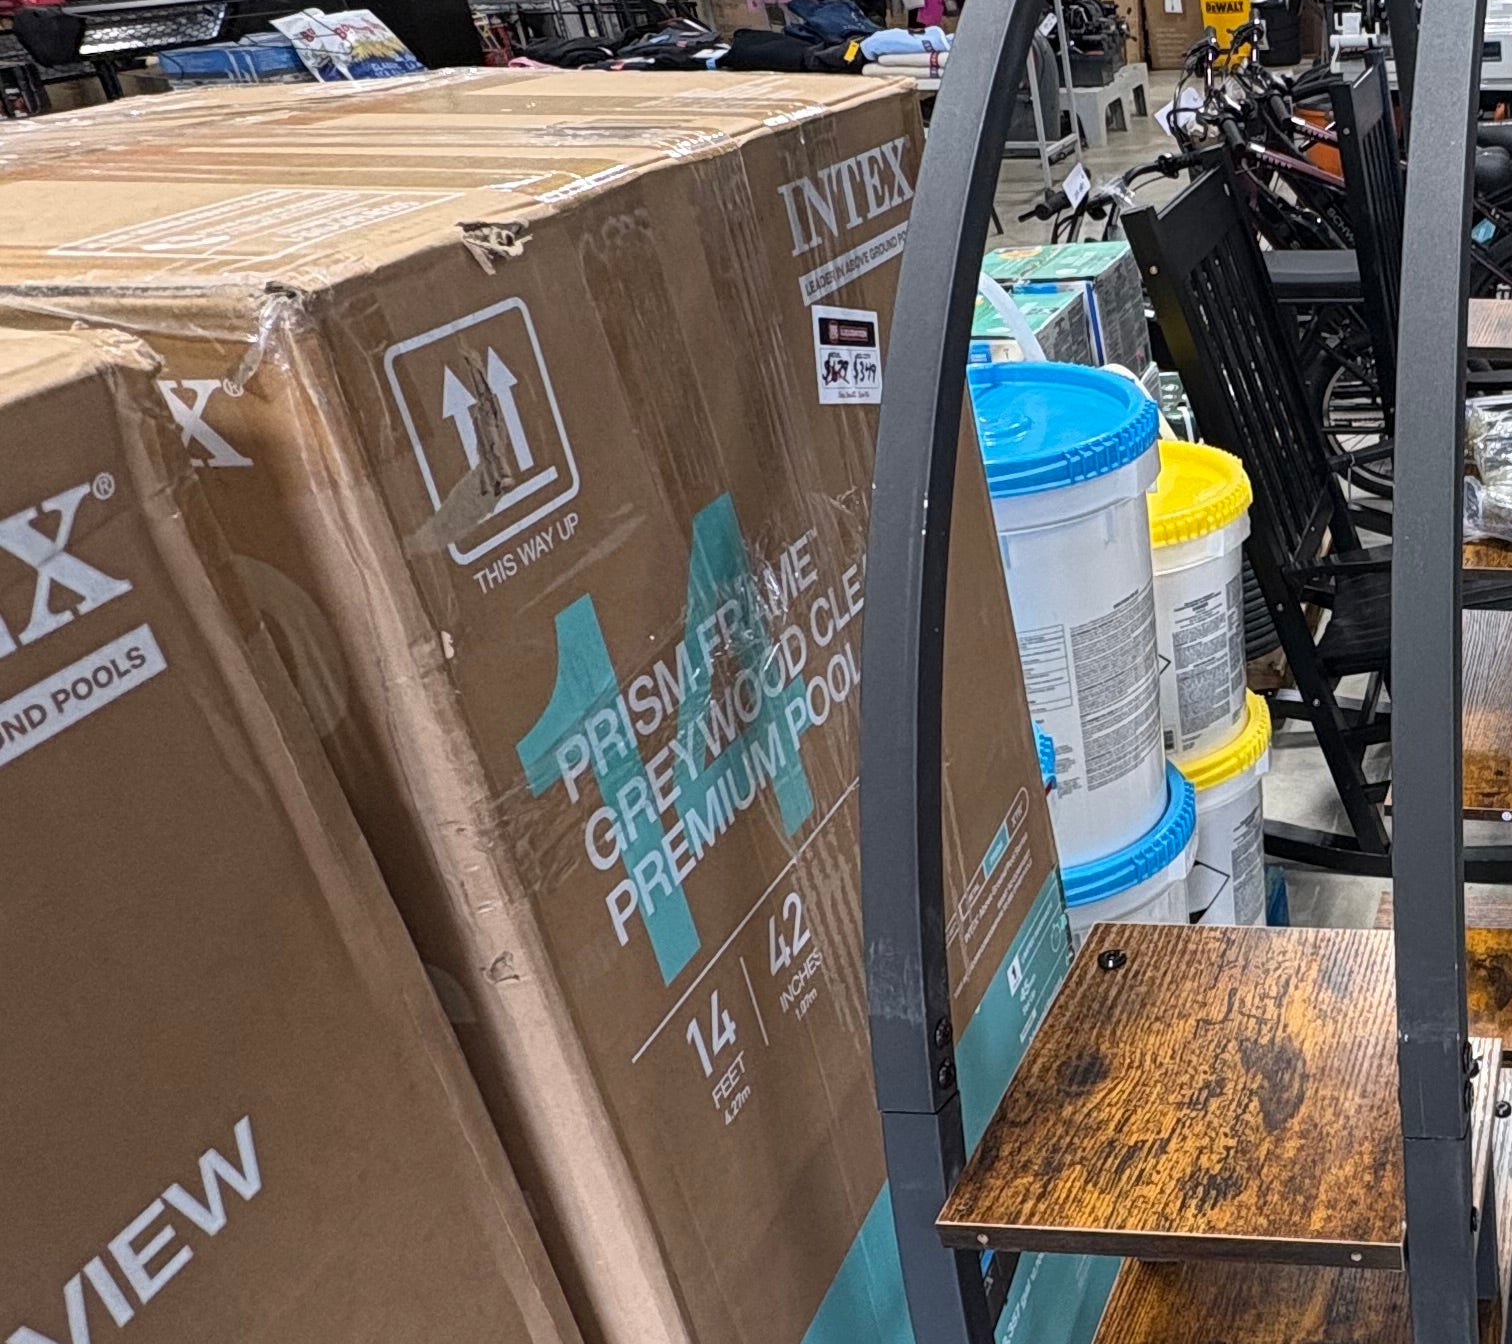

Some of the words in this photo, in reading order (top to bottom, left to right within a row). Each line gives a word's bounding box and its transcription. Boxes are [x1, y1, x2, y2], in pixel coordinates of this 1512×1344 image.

[1205, 1, 1244, 14] DEWALT
[778, 135, 914, 256] INTEX
[846, 251, 870, 274] ABOVE
[868, 236, 898, 261] GROUND
[473, 554, 518, 594] THIS
[516, 526, 554, 566] WAY
[556, 512, 579, 541] UP
[51, 646, 147, 714] POOLS
[556, 640, 703, 804] PRISM
[584, 624, 808, 871] GREYWOOD
[604, 721, 787, 947] PREMIUM
[769, 892, 811, 977] 42
[780, 946, 823, 1014] INCHES
[686, 988, 736, 1078] 14
[712, 1050, 746, 1110] FEET
[725, 1085, 751, 1126] 4.27m
